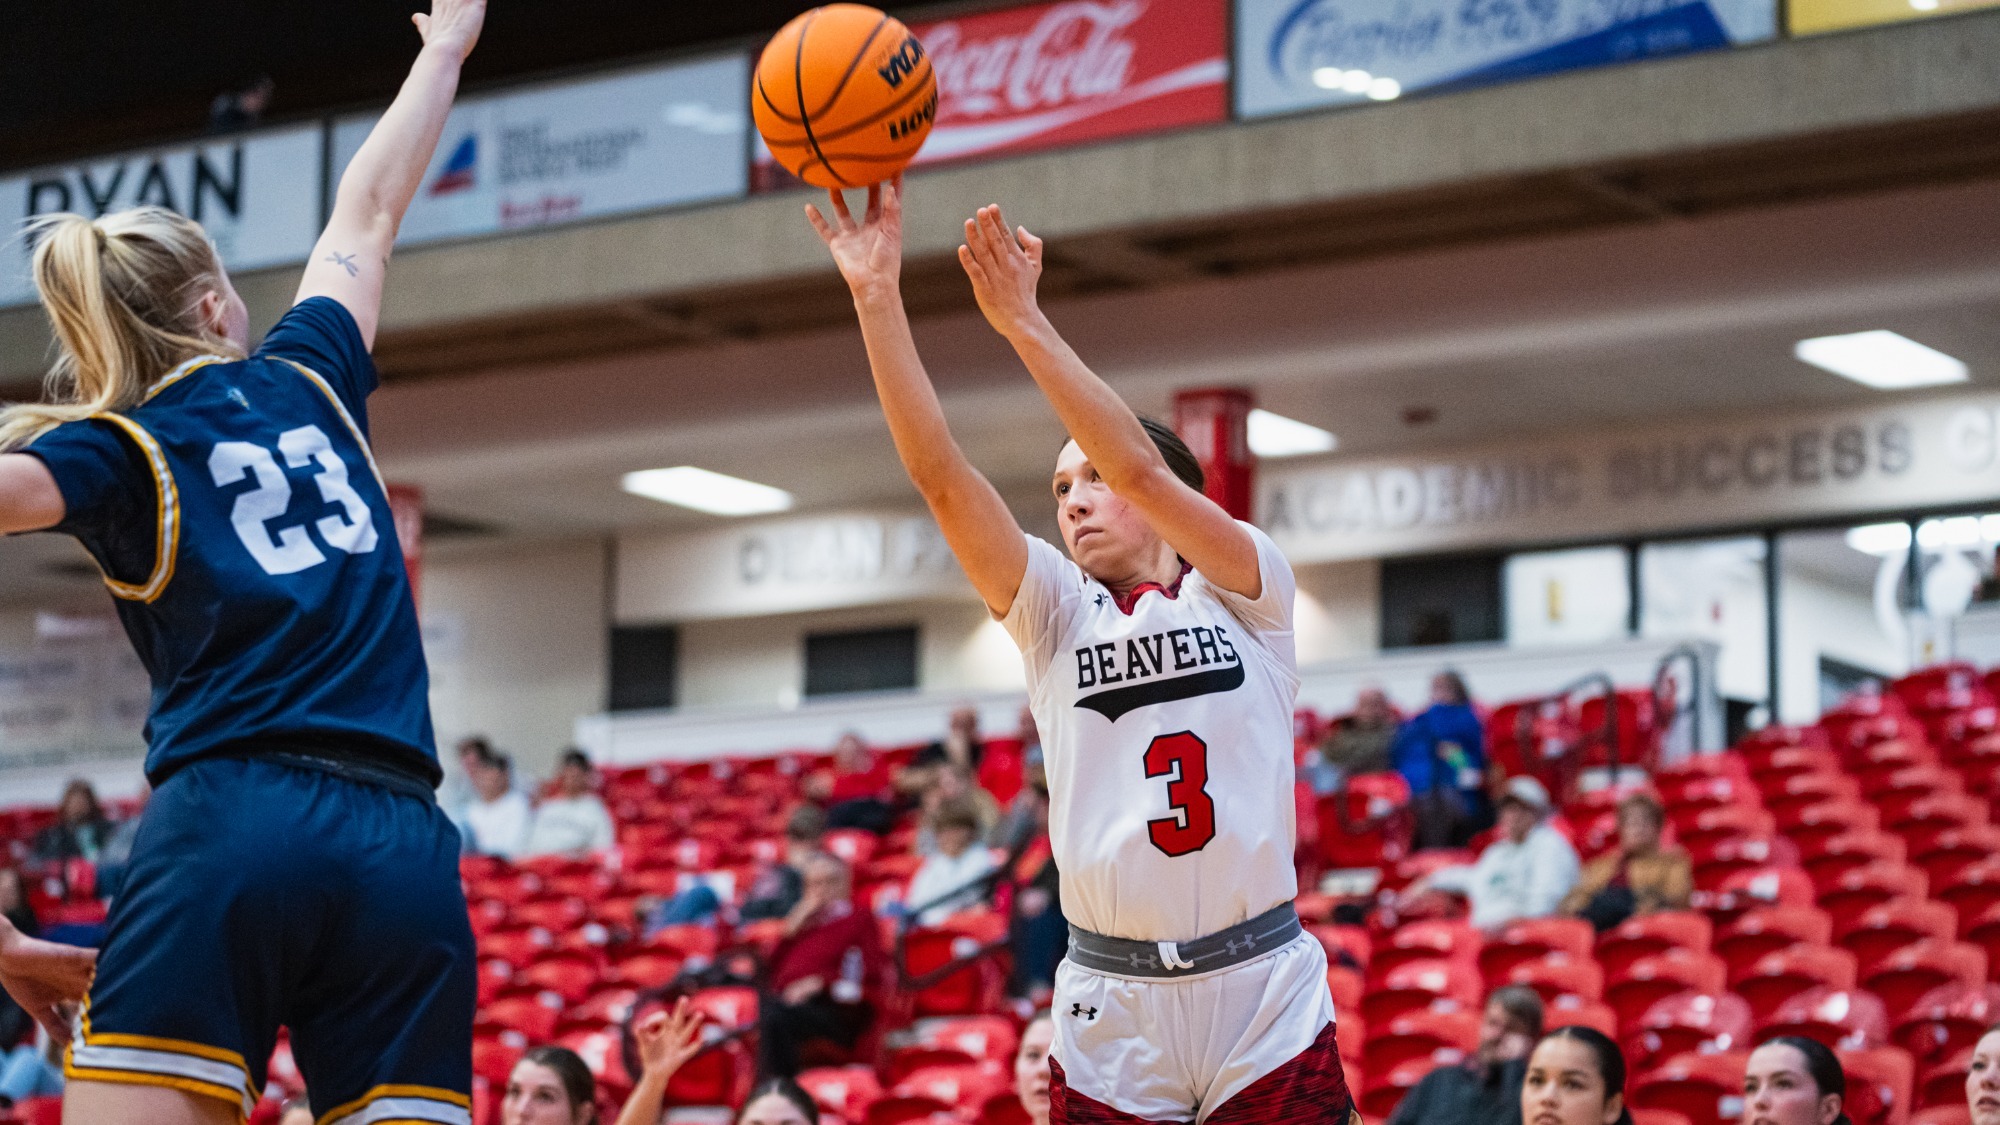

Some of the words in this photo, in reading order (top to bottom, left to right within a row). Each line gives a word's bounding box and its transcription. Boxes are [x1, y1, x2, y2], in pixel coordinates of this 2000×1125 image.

[207, 424, 379, 575] 23
[1607, 419, 1913, 499] SUCCESS
[1075, 624, 1238, 690] BEAVERS
[1142, 729, 1216, 858] 3
